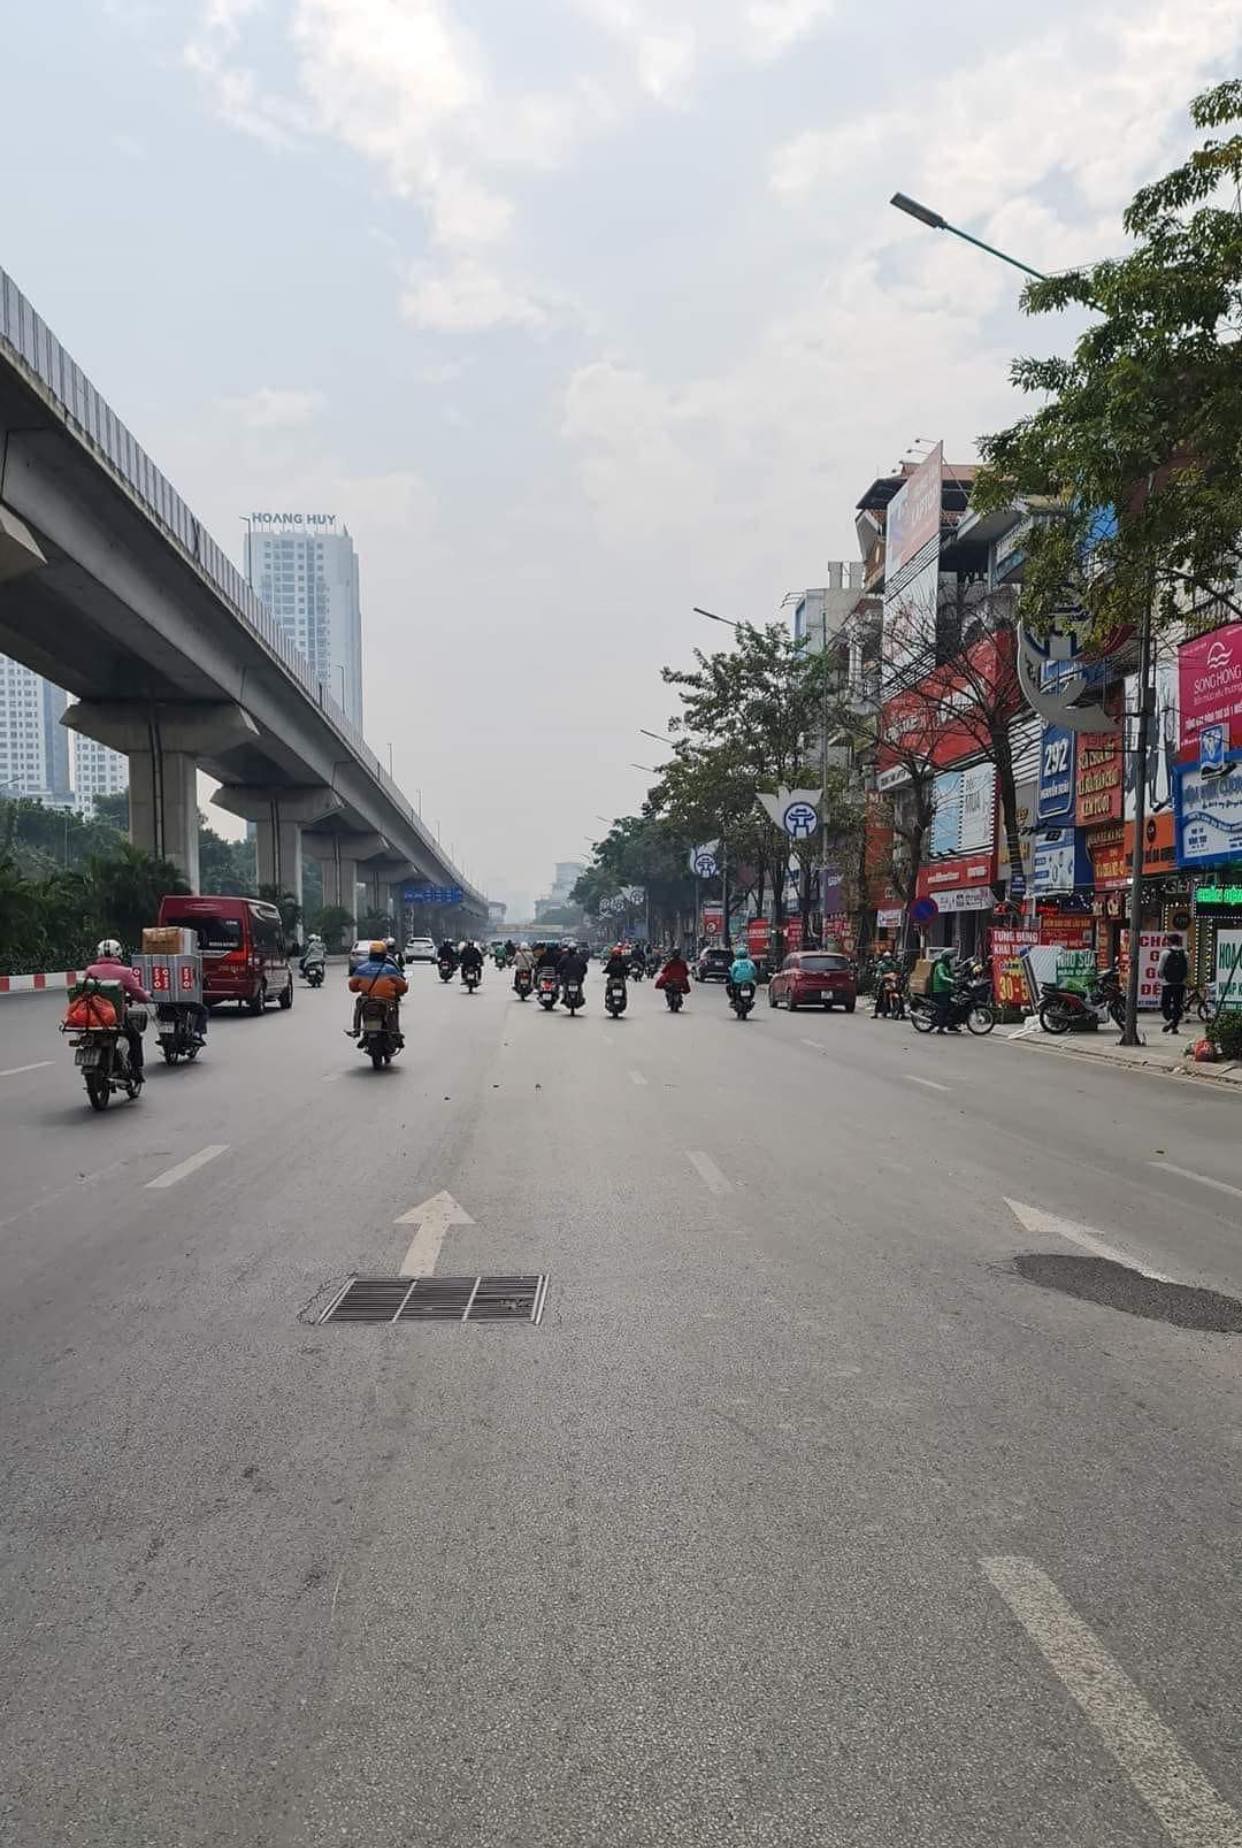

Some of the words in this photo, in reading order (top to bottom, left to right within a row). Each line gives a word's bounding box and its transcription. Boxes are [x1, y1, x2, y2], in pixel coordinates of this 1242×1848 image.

[252, 512, 303, 525] HOANG
[306, 513, 337, 526] HUY
[1043, 738, 1070, 778] 292
[1000, 976, 1014, 1000] 30
